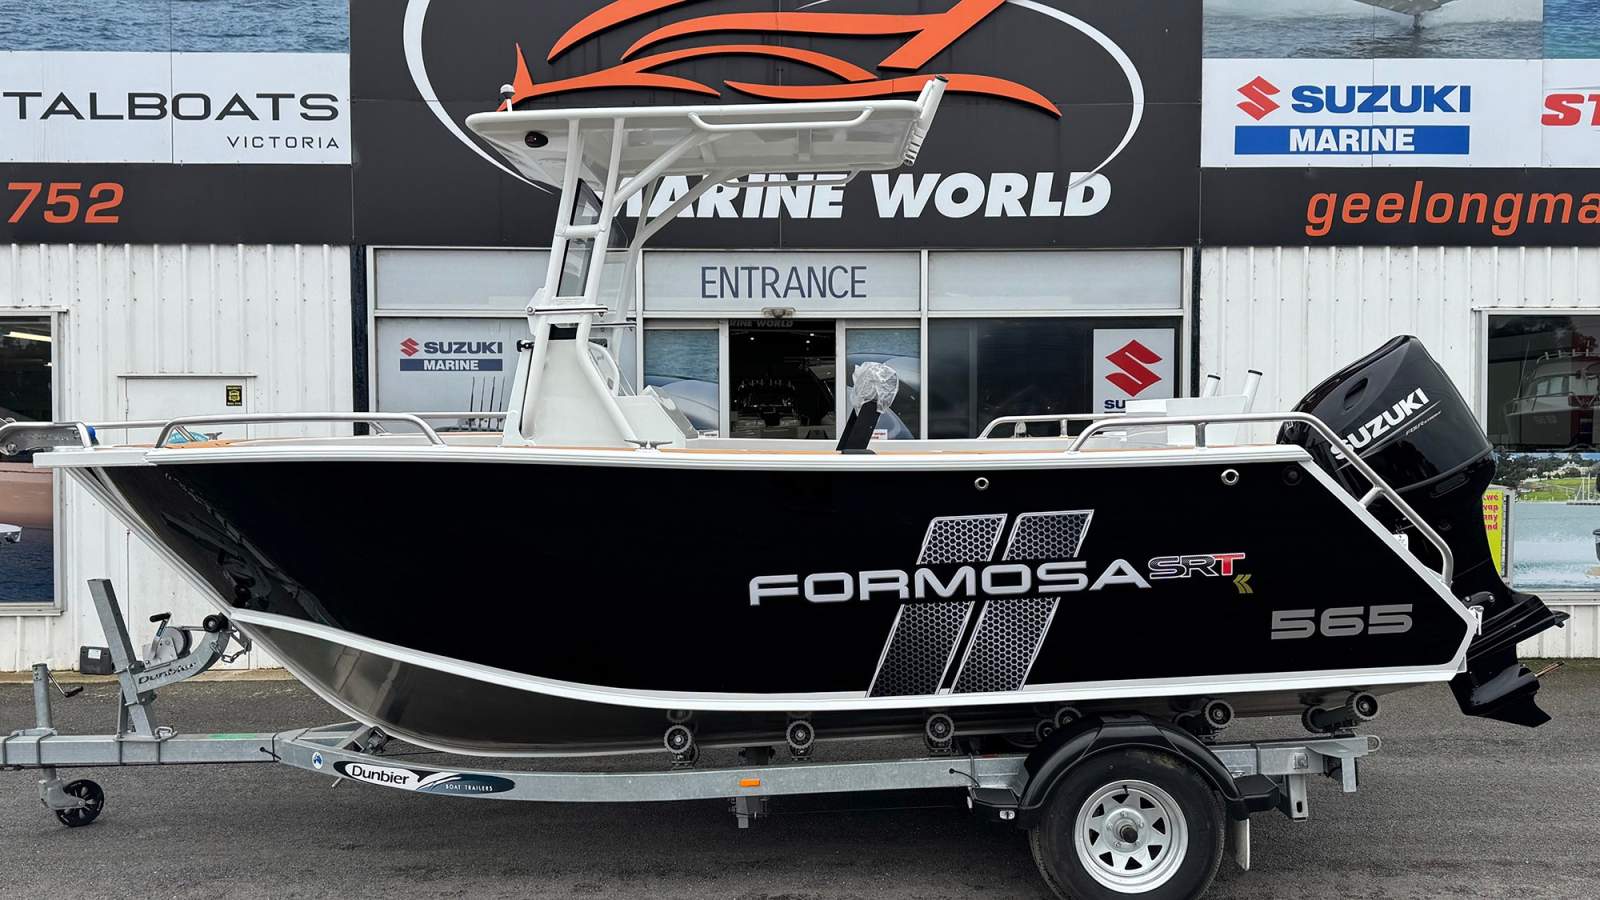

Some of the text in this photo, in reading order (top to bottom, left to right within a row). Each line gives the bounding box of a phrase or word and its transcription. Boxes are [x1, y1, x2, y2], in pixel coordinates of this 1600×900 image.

[3, 92, 339, 121] TALBOATS
[1291, 85, 1471, 114] SUZUKI
[227, 136, 339, 149] VICTORIA
[1289, 128, 1415, 152] MARINE
[8, 182, 124, 224] 752
[871, 172, 1111, 218] WORLD
[1305, 181, 1600, 237] geelongma
[701, 265, 867, 299] ENTRANCE
[423, 341, 503, 354] SUZUKI
[423, 359, 479, 371] MARINE
[1331, 387, 1430, 460] SUZUKI
[749, 552, 1246, 606] FORMOSA SRT
[1270, 603, 1413, 640] 565
[351, 765, 410, 785] Dunbier
[464, 784, 494, 792] TRAILERS
